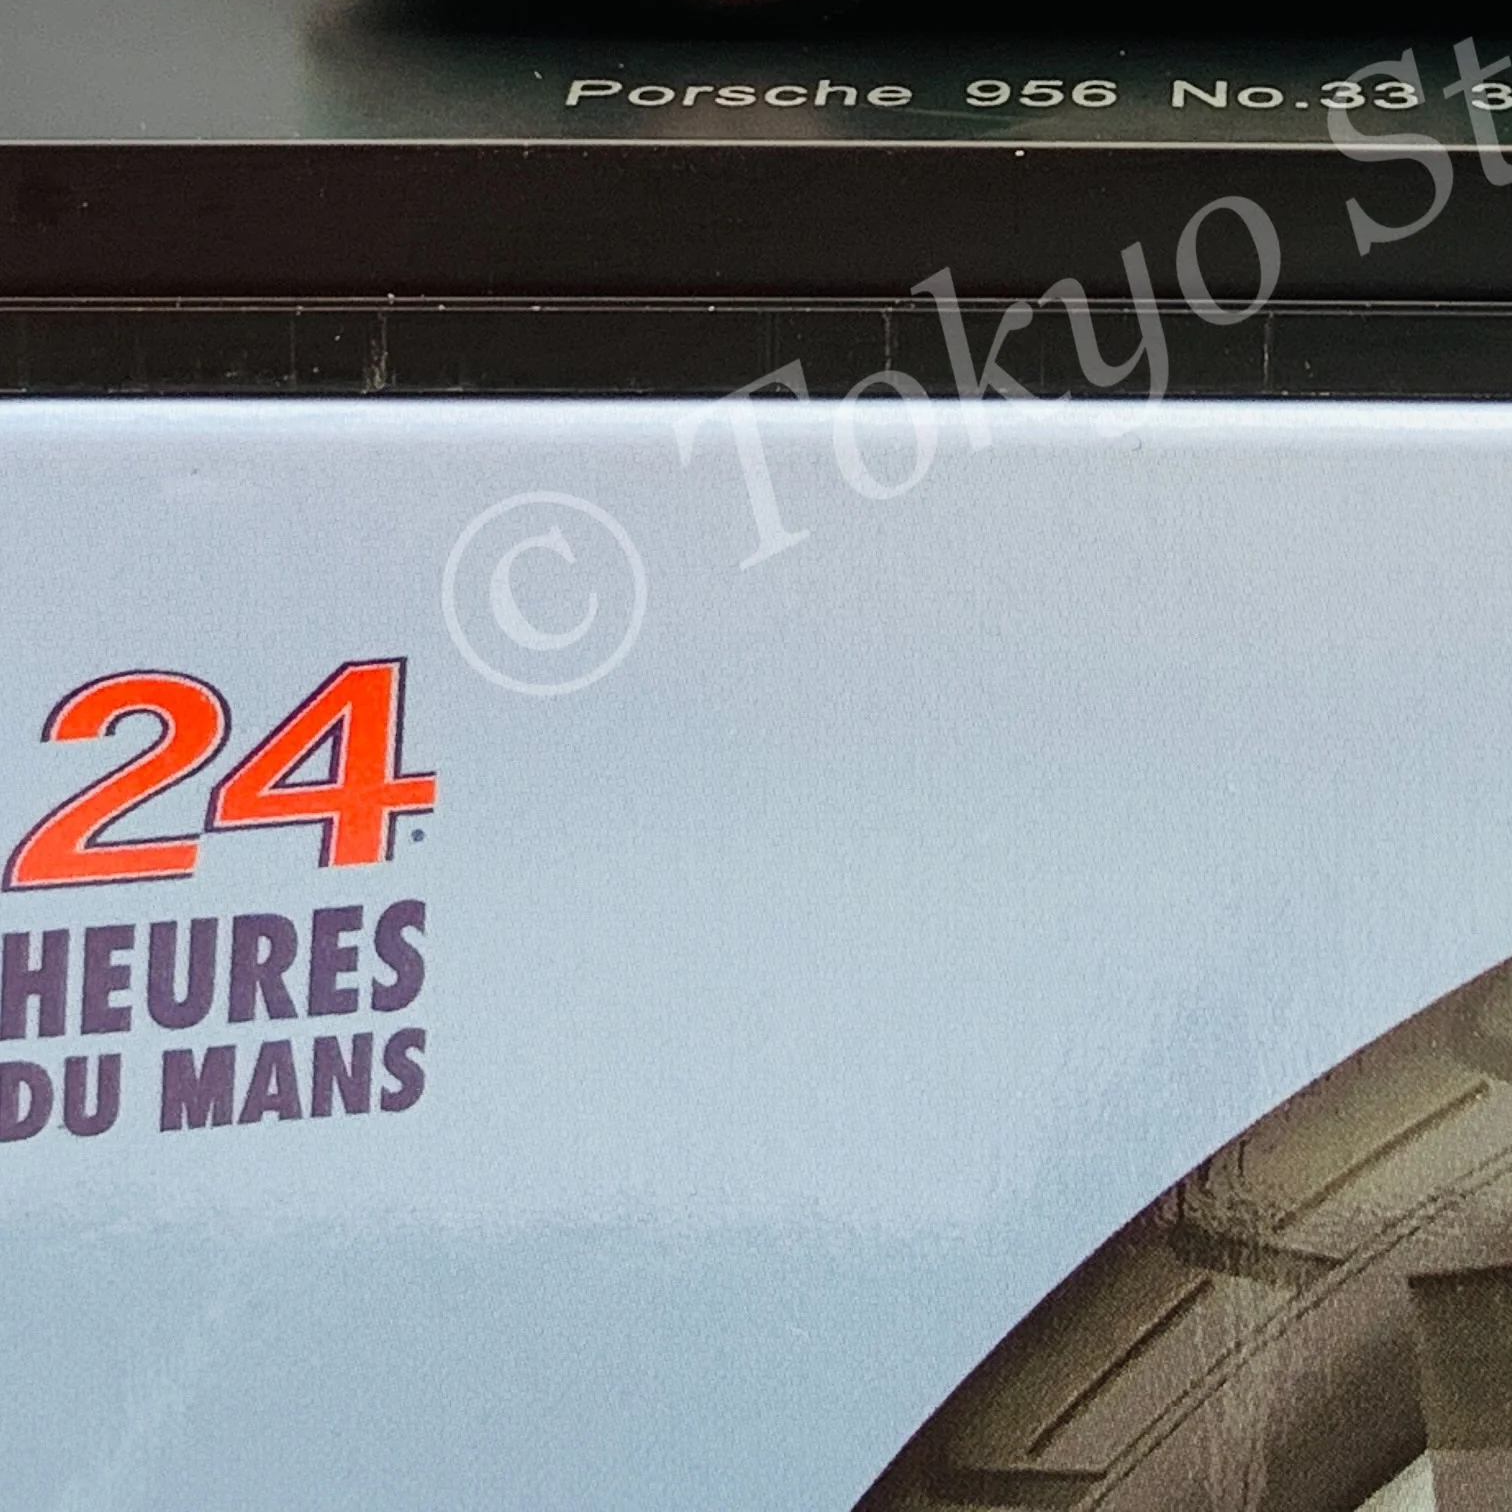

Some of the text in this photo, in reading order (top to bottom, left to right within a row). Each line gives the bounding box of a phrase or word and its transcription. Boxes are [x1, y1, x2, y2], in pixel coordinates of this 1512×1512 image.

[564, 78, 914, 108] Porsche
[965, 79, 1118, 108] 956
[1170, 79, 1421, 110] No.33
[2, 656, 440, 892] 24
[0, 899, 427, 1042] HEURES
[0, 1027, 428, 1144] DU MANS
